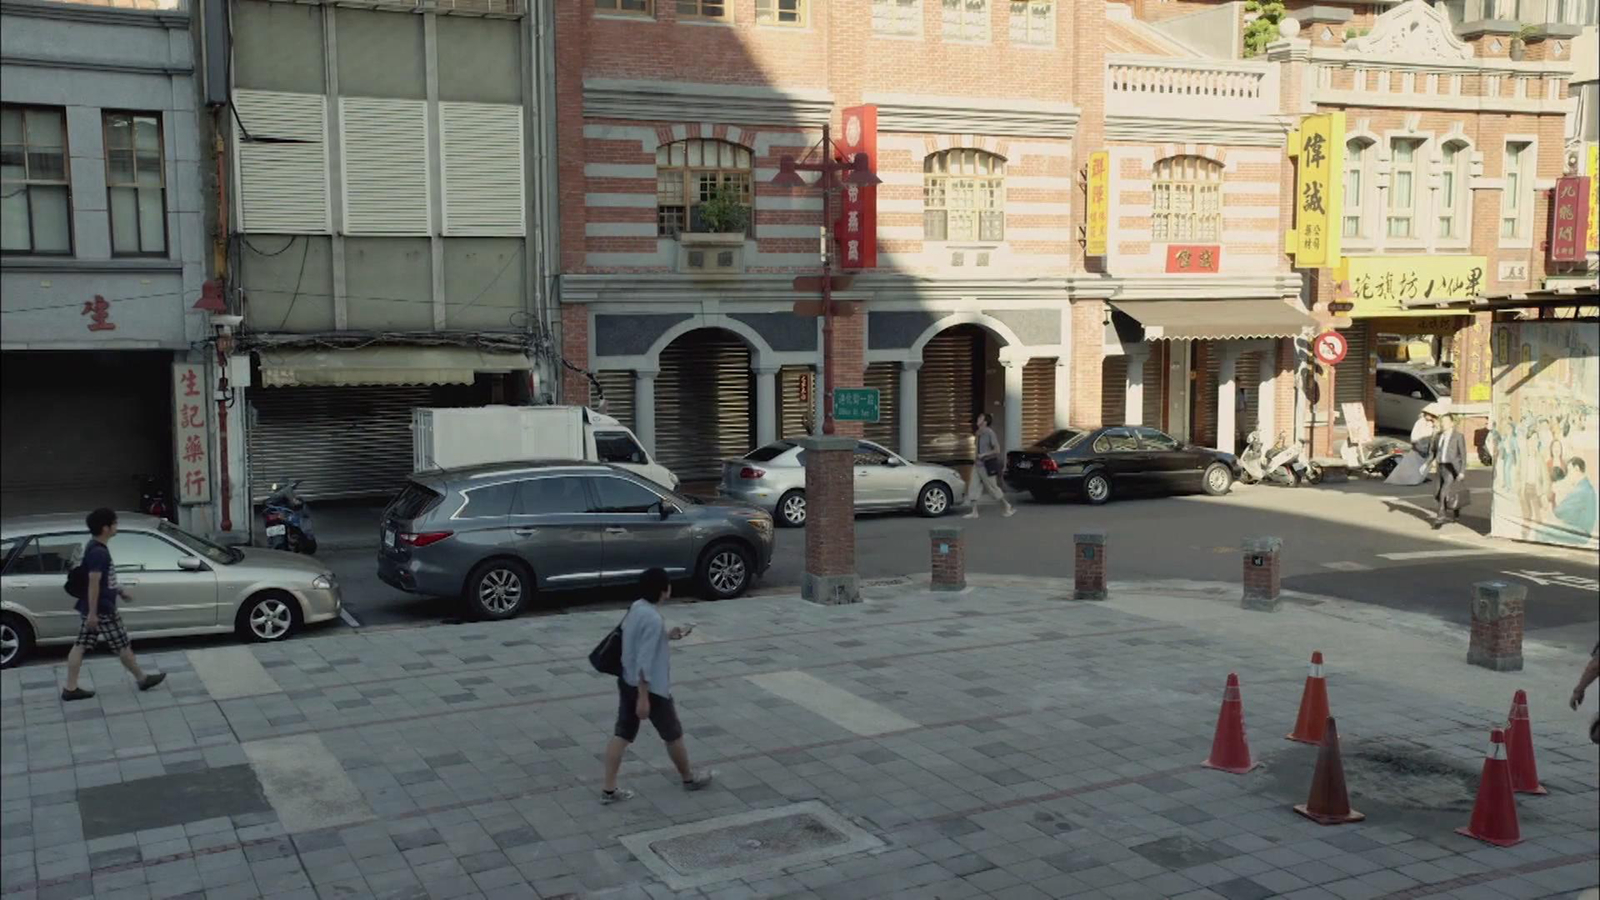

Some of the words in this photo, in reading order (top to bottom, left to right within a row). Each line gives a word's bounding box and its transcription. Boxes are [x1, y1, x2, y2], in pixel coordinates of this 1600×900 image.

[81, 294, 117, 332] 生
[180, 368, 206, 498] 生記藥行
